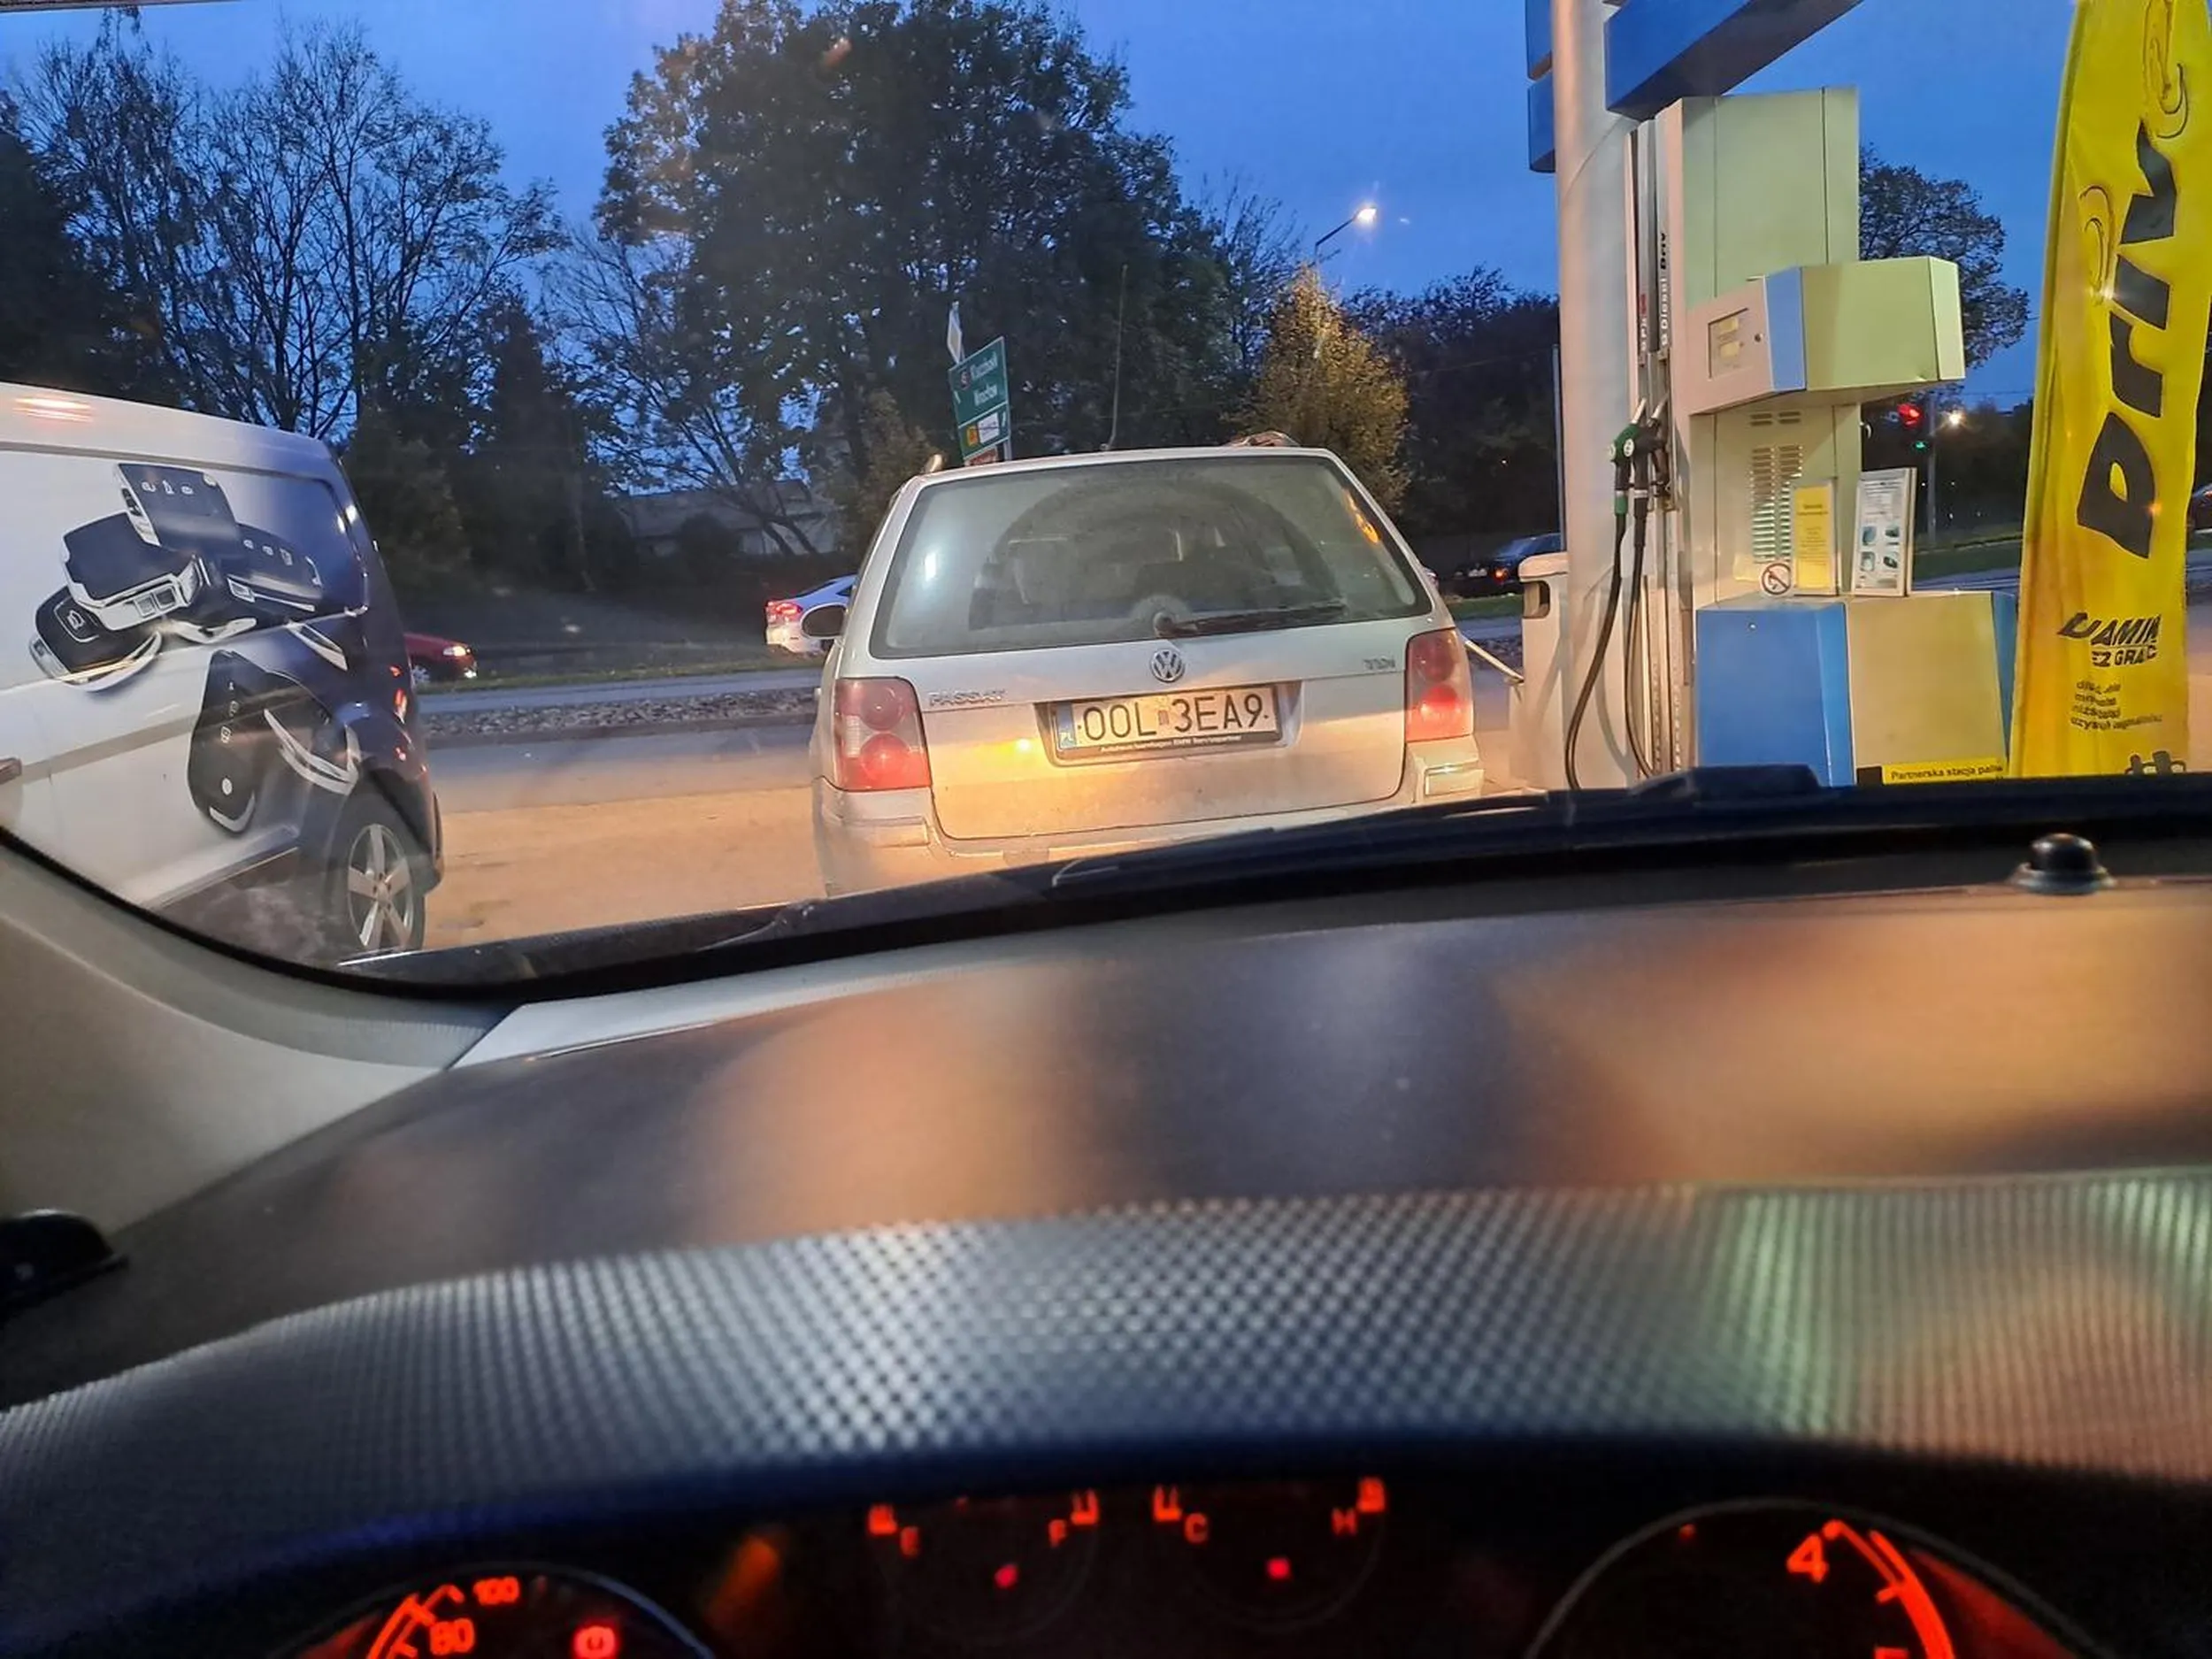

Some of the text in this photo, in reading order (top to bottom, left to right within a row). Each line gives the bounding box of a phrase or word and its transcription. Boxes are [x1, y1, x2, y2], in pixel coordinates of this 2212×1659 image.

[1171, 693, 1263, 733] 3EA9
[1185, 1512, 1208, 1543] C
[1786, 1533, 1828, 1583] 4
